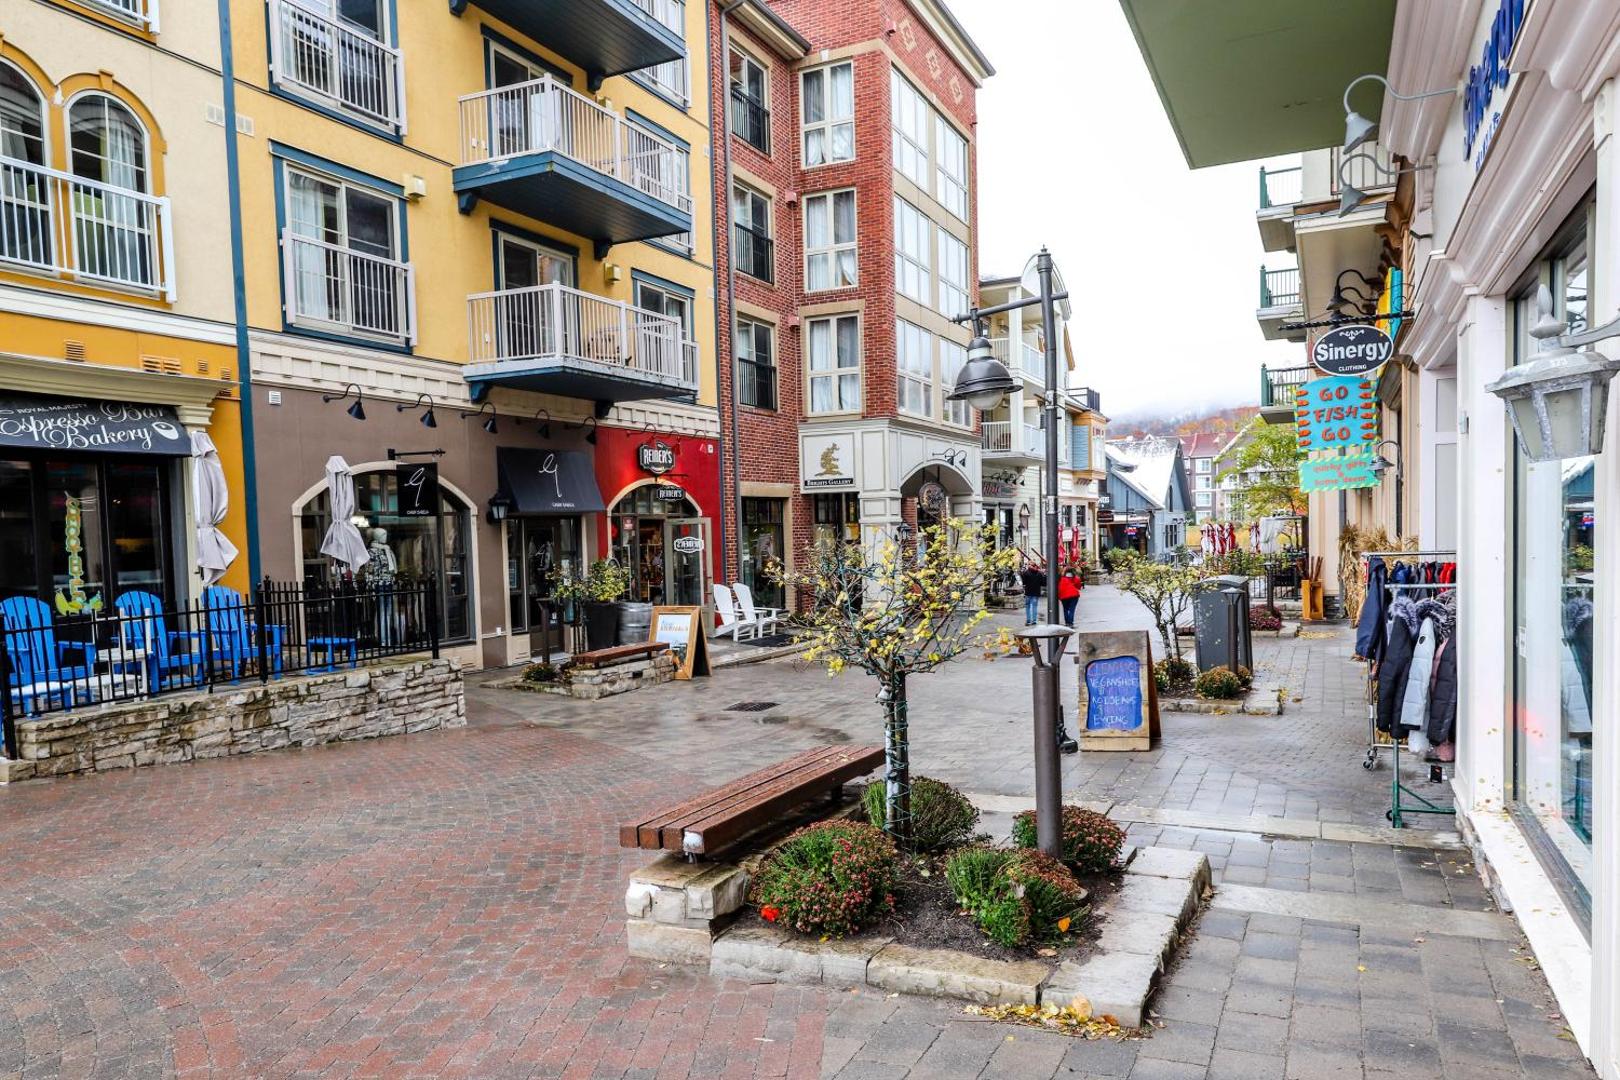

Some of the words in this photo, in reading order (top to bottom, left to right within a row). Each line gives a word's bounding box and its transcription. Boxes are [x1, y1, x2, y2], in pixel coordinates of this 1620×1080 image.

[1316, 340, 1389, 362] Sinergy
[1338, 364, 1367, 372] CLOTHING
[1319, 386, 1349, 401] GO
[0, 412, 99, 441] Espresso
[100, 401, 164, 423] Bar
[1313, 404, 1359, 423] FISH
[42, 425, 152, 449] Bakery
[1321, 427, 1351, 442] GO
